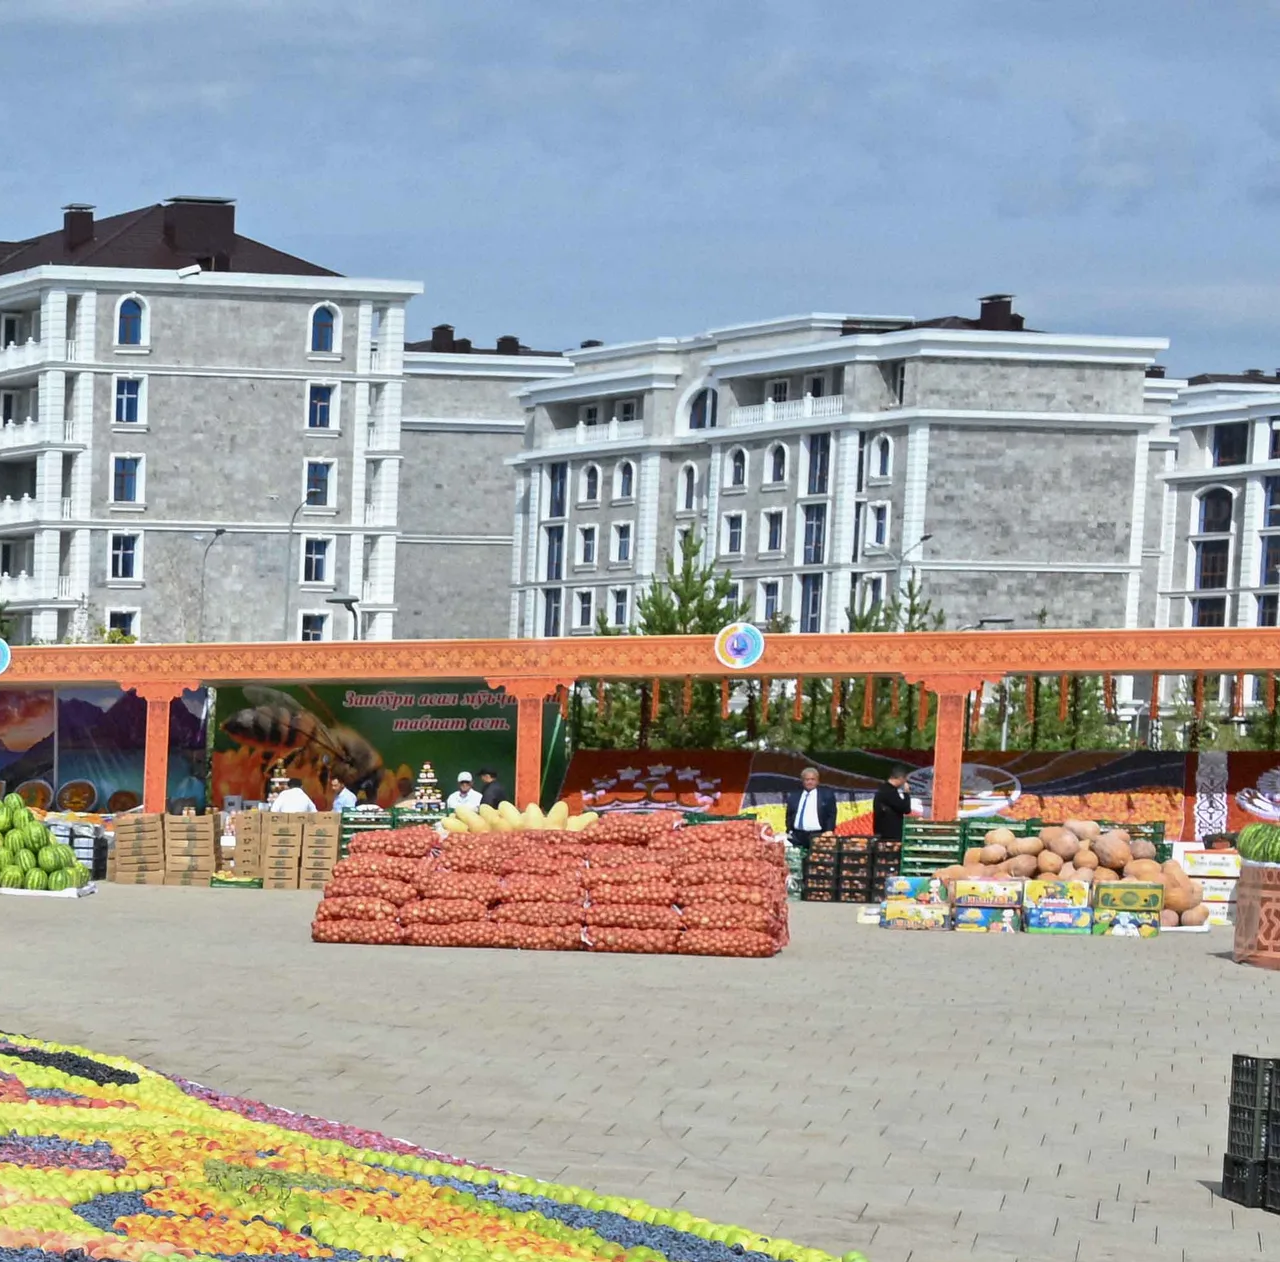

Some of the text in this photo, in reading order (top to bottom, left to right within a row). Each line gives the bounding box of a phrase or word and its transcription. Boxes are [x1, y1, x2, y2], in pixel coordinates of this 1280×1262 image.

[418, 694, 457, 705] асал
[393, 715, 510, 730] табиат аст.
